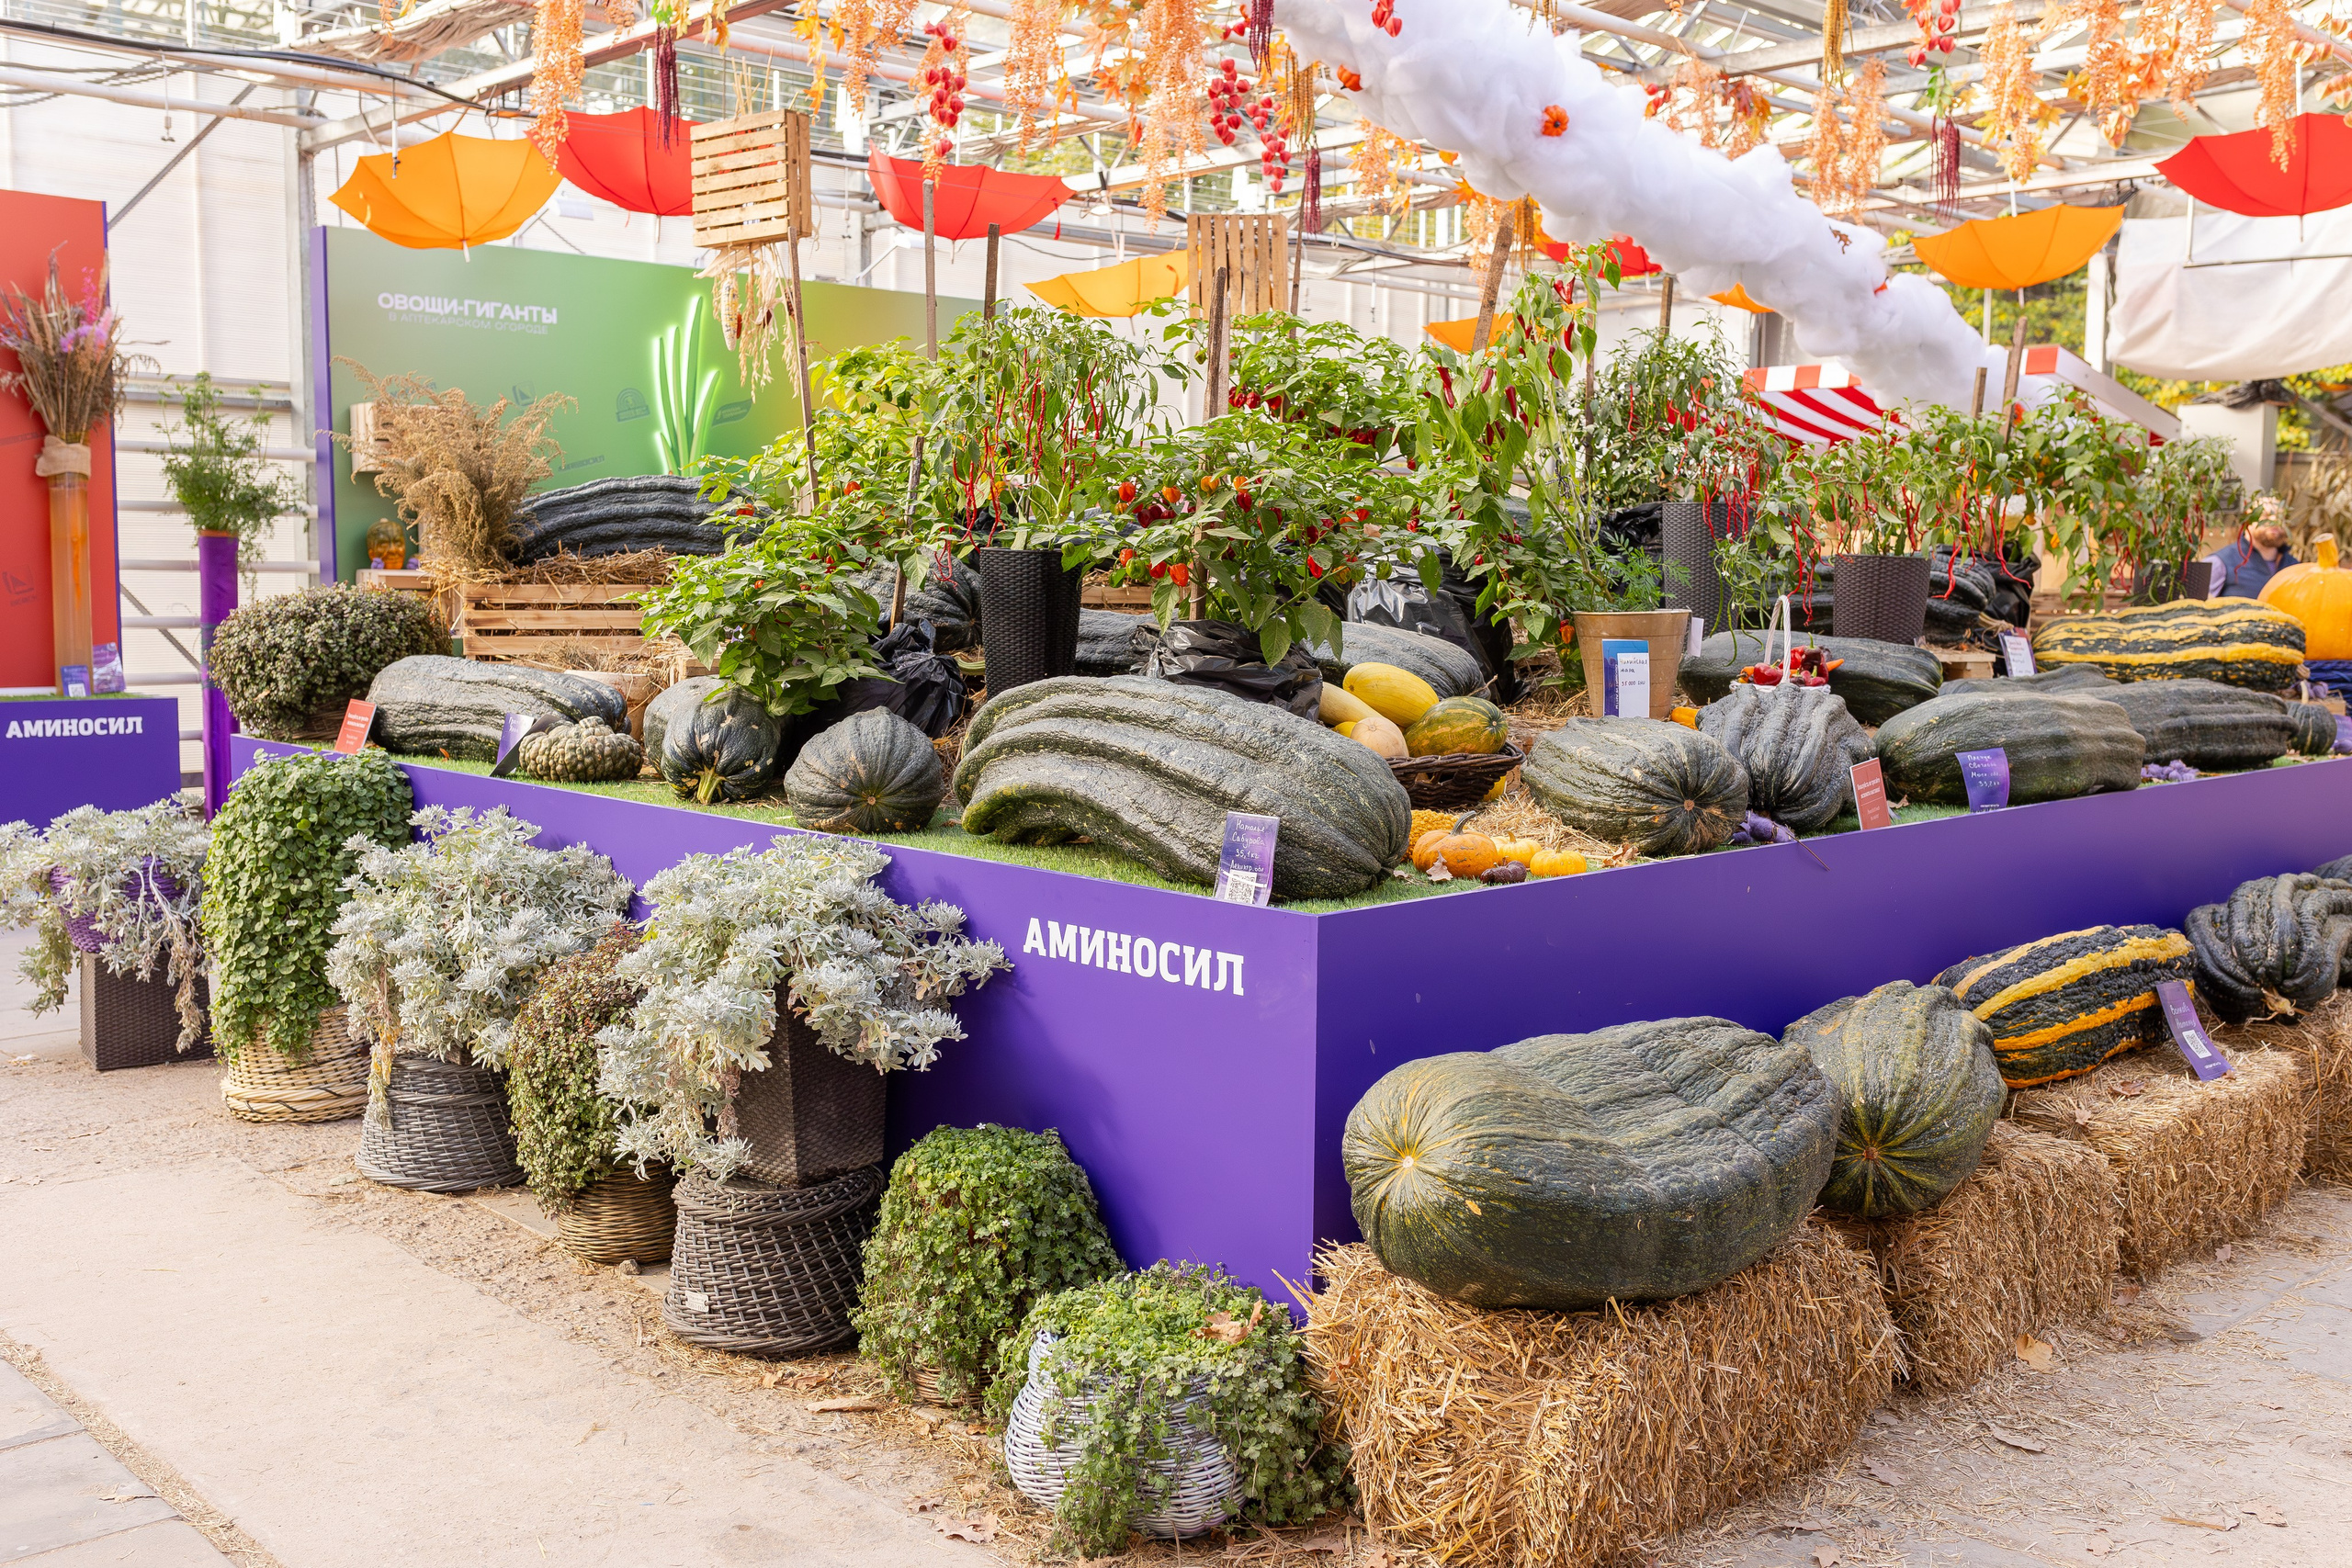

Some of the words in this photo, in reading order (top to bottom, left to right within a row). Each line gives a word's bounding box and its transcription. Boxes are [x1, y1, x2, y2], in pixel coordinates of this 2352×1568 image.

[377, 292, 558, 324] ОВОЩИ-ГИГАНТЫ
[388, 311, 397, 321] В
[401, 313, 492, 330] АПТЕКАРСКОМ
[494, 321, 548, 335] ОГОРОДЕ
[6, 716, 143, 739] АМИНОСИЛ
[1232, 832, 1265, 849] Сабурова
[1023, 917, 1245, 997] АМИНОСИЛ
